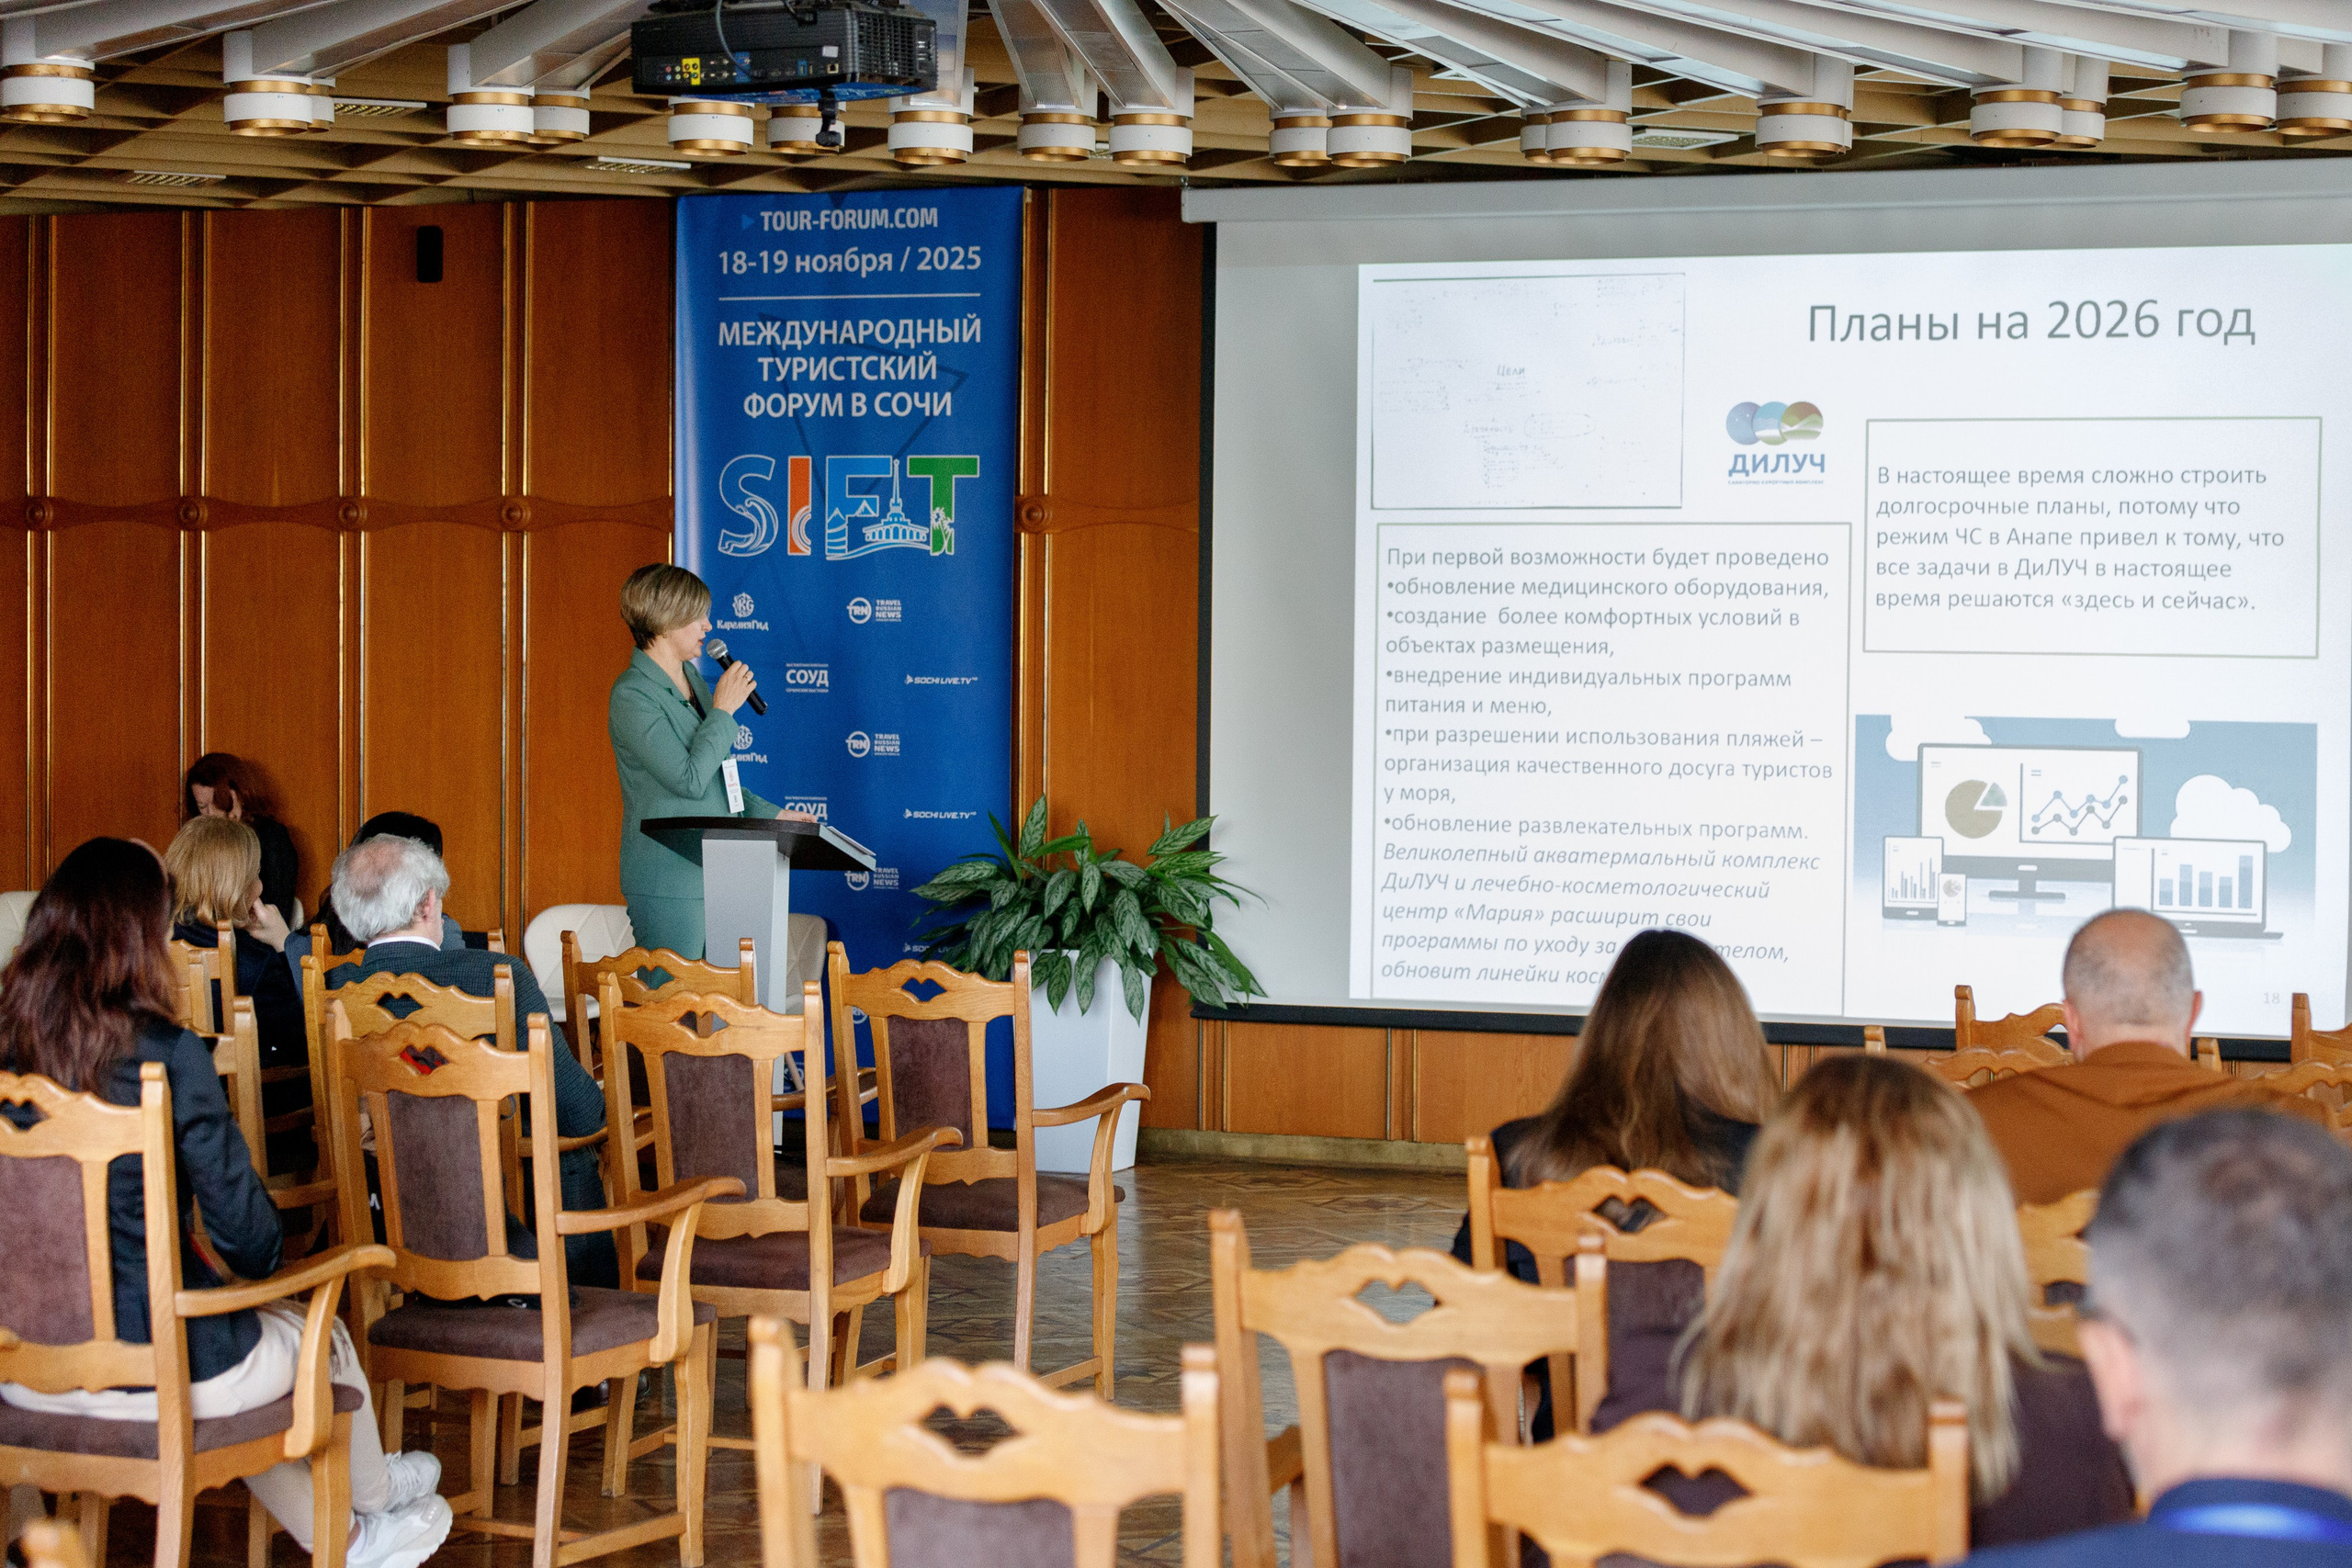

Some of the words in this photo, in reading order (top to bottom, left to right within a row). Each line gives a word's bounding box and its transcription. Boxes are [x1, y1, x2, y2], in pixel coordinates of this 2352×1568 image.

[760, 207, 939, 231] TOUR-FORUM.COM
[719, 249, 788, 274] 18-19
[795, 246, 893, 279] ноября
[916, 245, 981, 270] 2025
[719, 312, 981, 351] МЕЖДУНАРОДНЫЙ
[1809, 304, 1958, 342] Планы
[1978, 310, 2028, 339] на
[2047, 299, 2160, 338] 2026
[2178, 308, 2256, 346] год
[758, 350, 937, 381] ТУРИСТСКИЙ
[744, 391, 843, 418] ФОРУМ
[851, 391, 867, 416] В
[874, 391, 951, 416] СОЧИ
[1728, 453, 1825, 477] ДИЛУЧ
[1878, 466, 1889, 483] В
[1898, 470, 2010, 487] настоящее
[2018, 469, 2084, 487] время
[2092, 469, 2173, 483] сложно
[2181, 469, 2267, 488] строить
[718, 454, 980, 561] SIFT
[1876, 501, 2029, 518] долгосрочные
[2037, 501, 2110, 517] планы,
[2119, 501, 2198, 519] потому
[2205, 501, 2240, 515] что
[1877, 531, 1948, 549] режим
[1956, 527, 1982, 545] ЧС
[1990, 531, 2000, 545] в
[2006, 527, 2072, 545] Анапе
[2081, 532, 2158, 550] привел
[2166, 532, 2176, 546] к
[2183, 532, 2241, 550] тому,
[2249, 532, 2284, 546] что
[1388, 547, 1425, 569] При
[1433, 547, 1503, 569] первой
[1511, 551, 1645, 565] возможности
[1652, 547, 1709, 569] будет
[1716, 552, 1829, 569] проведено
[1877, 561, 1910, 575] все
[1917, 561, 1990, 579] задачи
[1998, 562, 2008, 575] в
[2014, 558, 2087, 580] ДиЛУЧ
[2096, 562, 2106, 576] в
[2115, 563, 2231, 581] настоящее
[1395, 576, 1515, 595] обновление
[1522, 581, 1668, 598] медицинского
[1674, 577, 1828, 599] оборудования,
[1876, 592, 1940, 610] время
[1948, 593, 2053, 610] решаются
[2062, 594, 2135, 611] «здесь
[2143, 595, 2154, 608] и
[2161, 590, 2255, 609] сейчас».
[1394, 610, 1486, 628] создание
[1498, 606, 1558, 624] более
[1565, 606, 1692, 629] комфортных
[1698, 607, 1781, 629] условий
[1789, 613, 1799, 626] в
[1386, 635, 1475, 653] объектах
[1481, 640, 1614, 658] размещения,
[786, 669, 829, 687] СОУД
[1394, 670, 1502, 687] внедрение
[1509, 671, 1681, 688] индивидуальных
[1689, 672, 1791, 690] программ
[1386, 699, 1465, 713] питания
[1472, 700, 1482, 713] и
[1490, 700, 1551, 717] меню,
[1393, 728, 1428, 745] при
[1436, 728, 1559, 746] разрешении
[1566, 731, 1719, 746] использования
[1727, 729, 1803, 747] пляжей
[1384, 758, 1509, 776] организация
[1517, 760, 1662, 775] качественного
[1668, 762, 1734, 780] досуга
[1742, 763, 1832, 781] туристов
[1383, 786, 1394, 804] у
[1400, 787, 1456, 804] моря,
[1391, 813, 1512, 833] обновление
[1519, 819, 1692, 837] развлекательных
[1699, 823, 1808, 841] программ.
[1383, 842, 1527, 862] Великолепный
[1534, 850, 1716, 868] акватермальный
[1721, 854, 1820, 869] комплекс
[1380, 872, 1449, 893] ДиЛУЧ
[1455, 877, 1466, 890] и
[1470, 874, 1770, 899] лечебно-косметологический
[1383, 906, 1447, 923] центр
[1455, 903, 1544, 924] «Мария»
[1550, 909, 1659, 928] расширит
[1666, 913, 1711, 927] свои
[1382, 934, 1498, 952] программы
[1504, 938, 1527, 951] по
[1534, 935, 1590, 957] уходу
[1594, 941, 1617, 954] за
[1381, 960, 1470, 979] обновит
[1476, 964, 1560, 982] линейки
[2263, 992, 2280, 1004] 18
